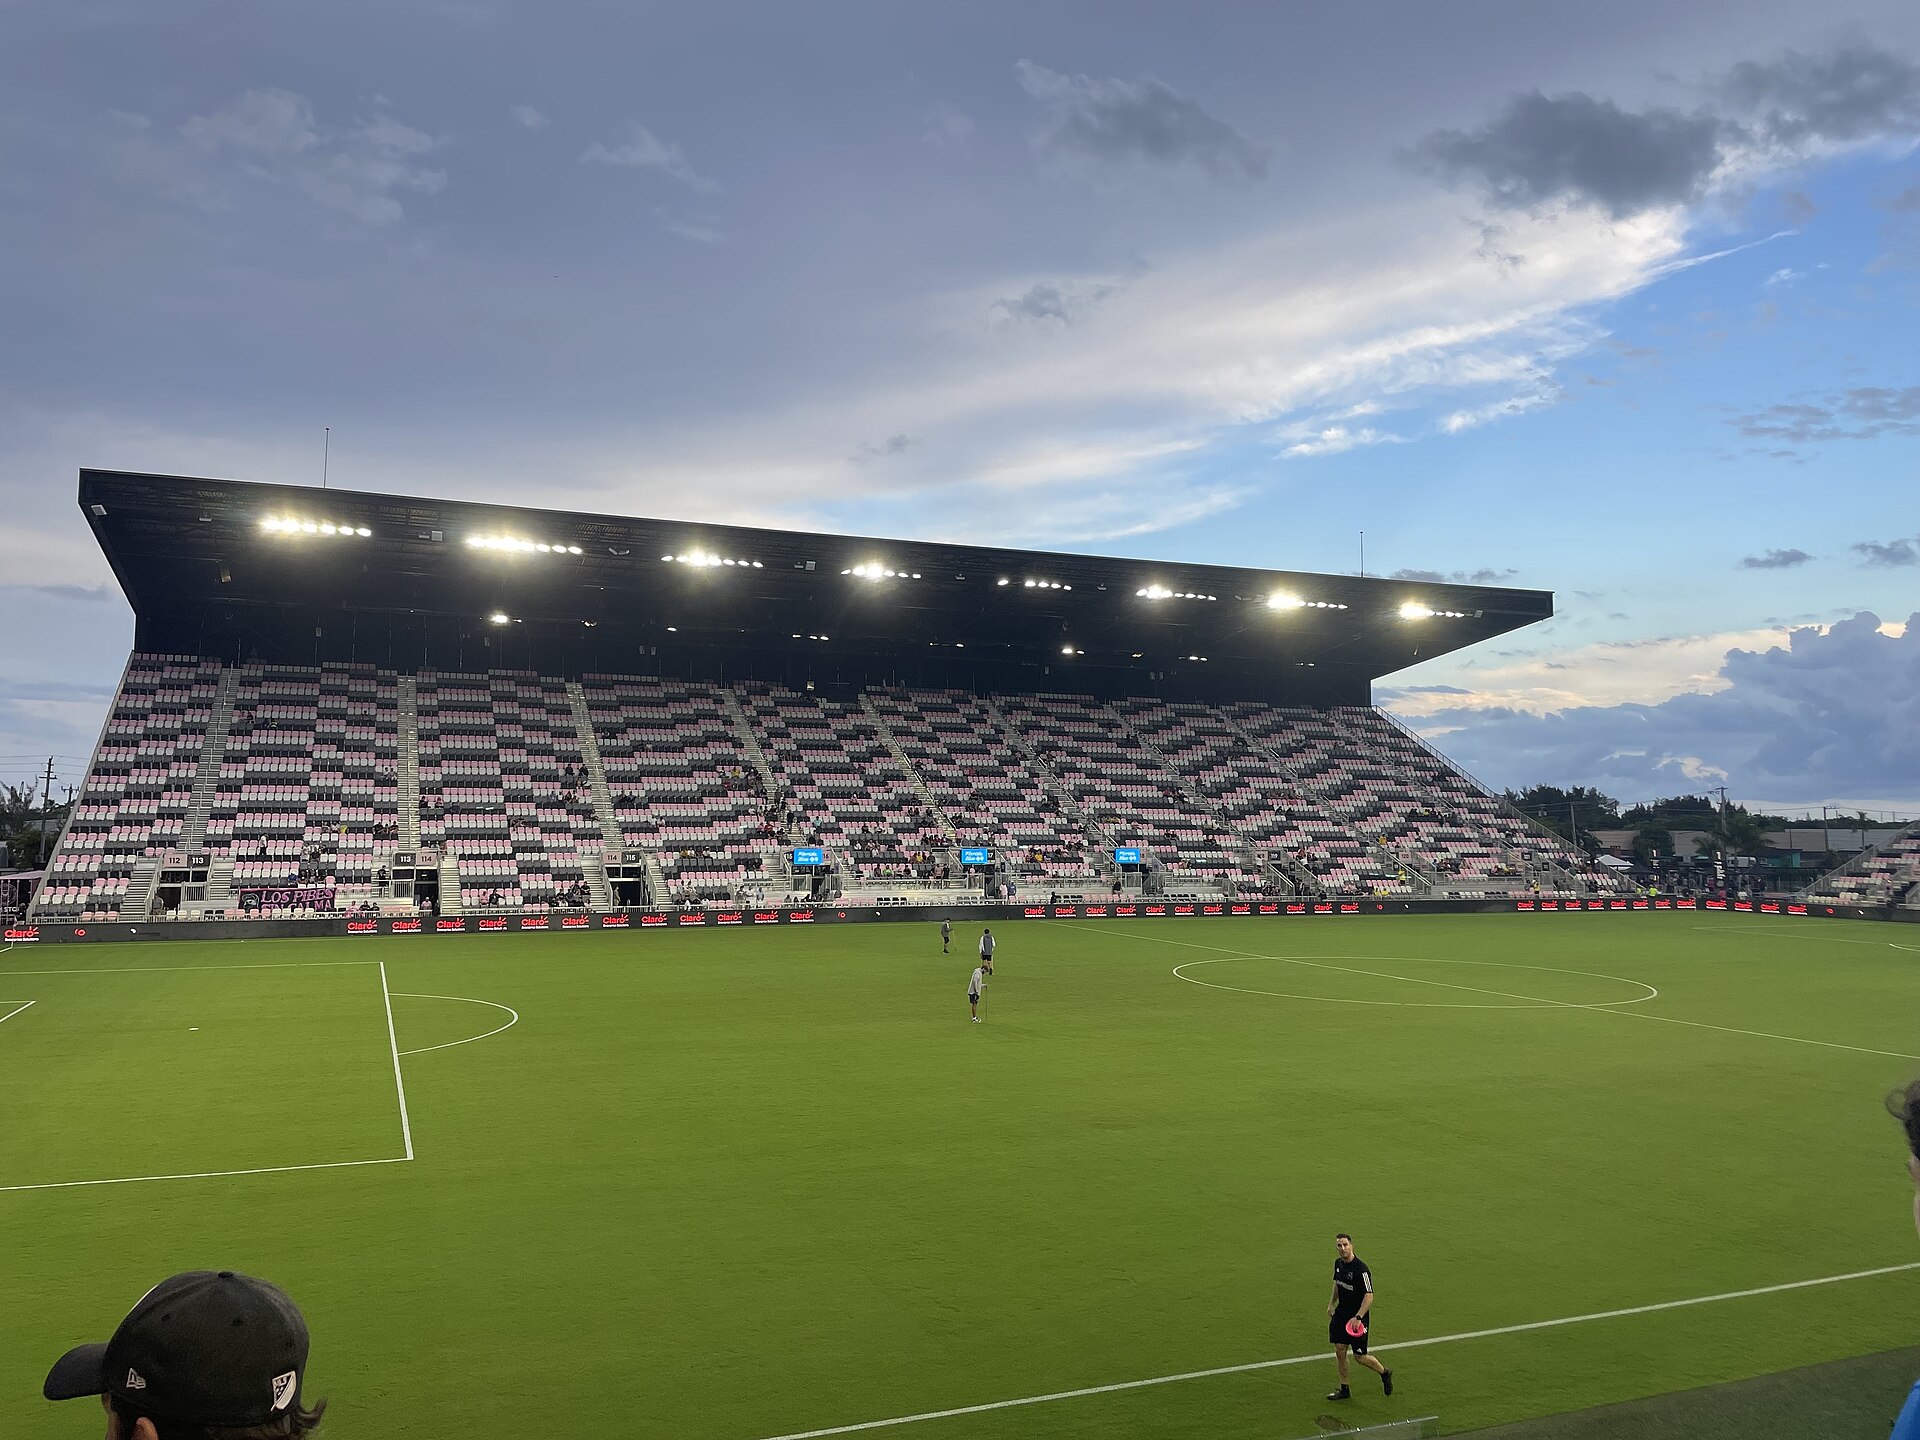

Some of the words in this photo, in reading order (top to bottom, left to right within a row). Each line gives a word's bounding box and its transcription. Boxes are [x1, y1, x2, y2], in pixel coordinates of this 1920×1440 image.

[260, 890, 290, 903] LOS
[292, 888, 334, 903] PIBES
[522, 917, 545, 926] Claro
[563, 917, 586, 925] Claro
[603, 915, 625, 924] Claro
[642, 915, 664, 923] Claro
[680, 913, 702, 922] Claro
[718, 913, 739, 921] Claro
[755, 913, 776, 921] Claro
[348, 921, 373, 930] Claro
[392, 920, 418, 929] Claro
[437, 919, 462, 928] Claro
[480, 918, 504, 927] Claro
[5, 928, 34, 938] Claro
